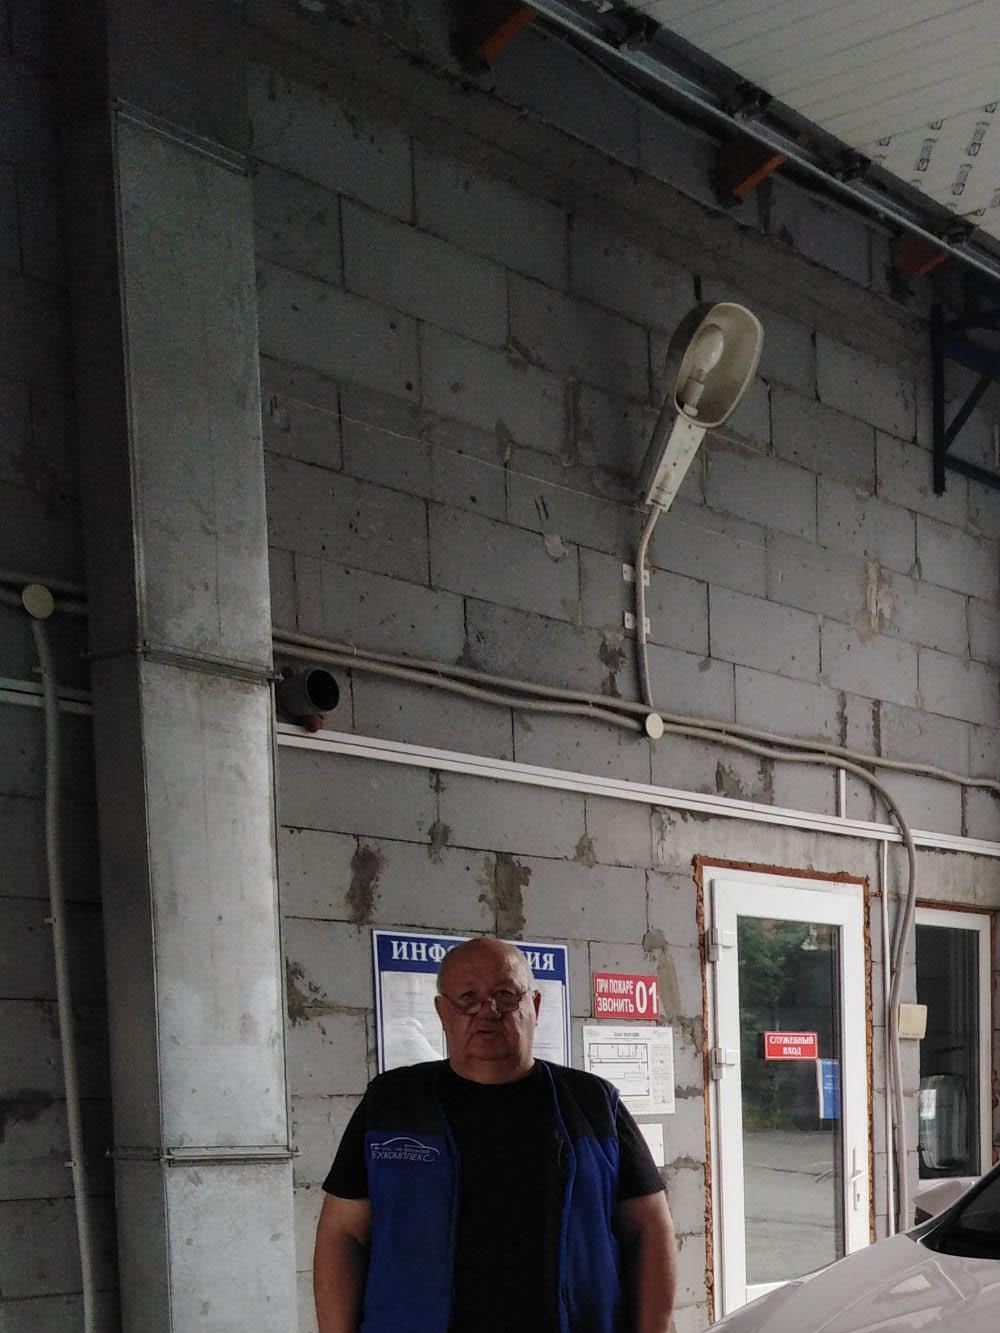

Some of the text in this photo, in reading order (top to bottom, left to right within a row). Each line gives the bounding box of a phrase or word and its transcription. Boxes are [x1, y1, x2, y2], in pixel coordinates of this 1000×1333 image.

[391, 940, 555, 971] ИНФИЯ
[596, 977, 634, 994] ПРИ ПОЖАРЕ
[635, 980, 658, 1014] 01
[597, 997, 635, 1013] ЗВОНИТЬ
